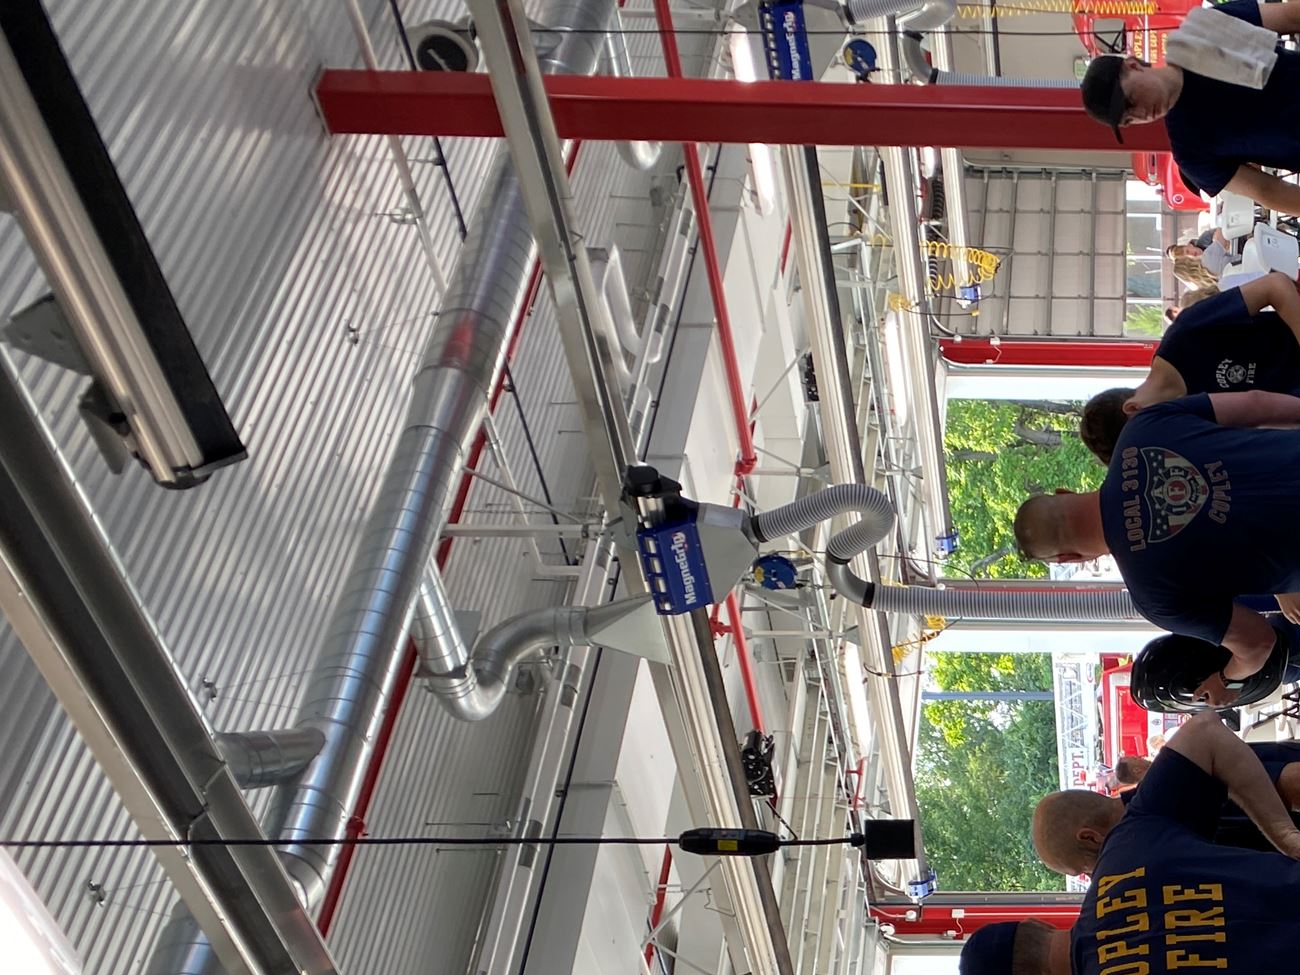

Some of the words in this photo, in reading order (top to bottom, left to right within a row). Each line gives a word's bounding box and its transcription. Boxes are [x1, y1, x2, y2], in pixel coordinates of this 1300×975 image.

[1216, 358, 1232, 388] COPLEY
[1246, 362, 1256, 384] FIRE
[1122, 446, 1138, 492] 3130
[1204, 460, 1232, 524] COPLEY
[1123, 494, 1146, 551] LOCAL
[671, 532, 696, 604] MagneGrip
[1162, 884, 1228, 970] FIRE
